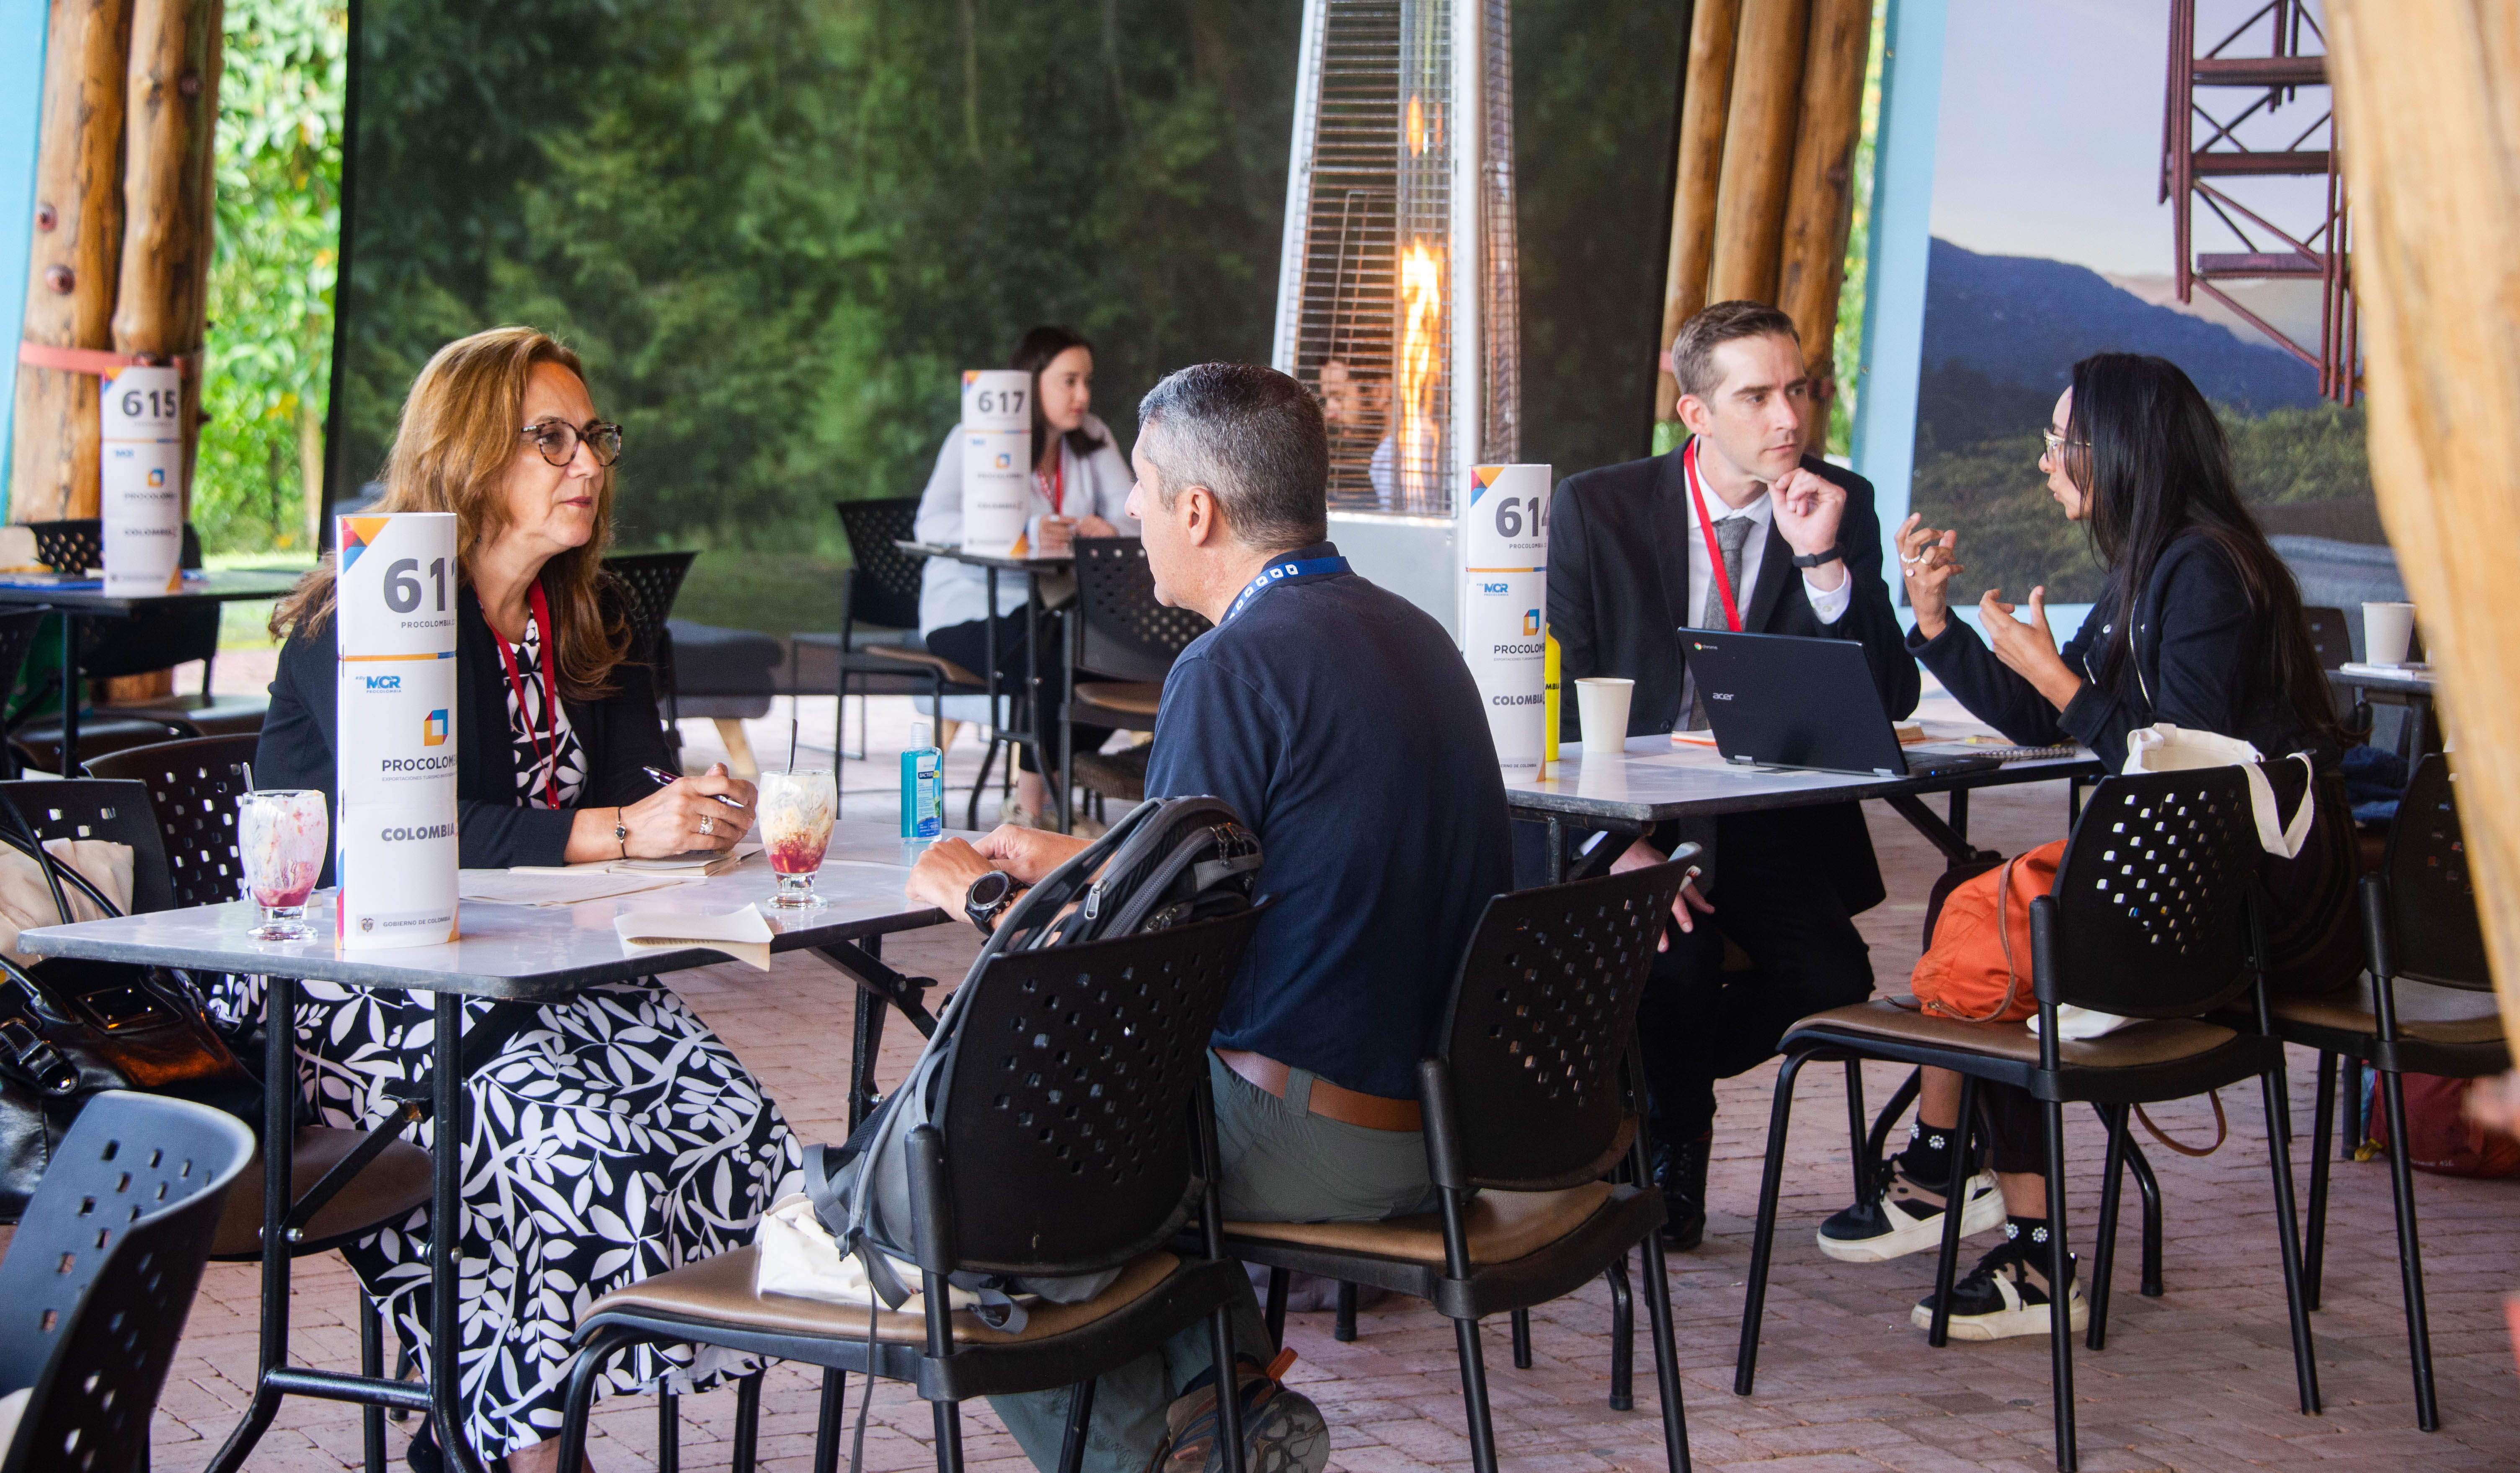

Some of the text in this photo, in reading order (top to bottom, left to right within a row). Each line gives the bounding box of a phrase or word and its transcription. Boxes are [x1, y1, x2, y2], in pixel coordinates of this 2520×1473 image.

[122, 389, 176, 418] 615
[978, 389, 1025, 413] 617
[1484, 583, 1508, 593] MCR
[367, 675, 401, 689] MCR
[1492, 694, 1542, 705] COLOMBIA
[1712, 692, 1734, 701] acer
[382, 822, 455, 841] COLOMBIA
